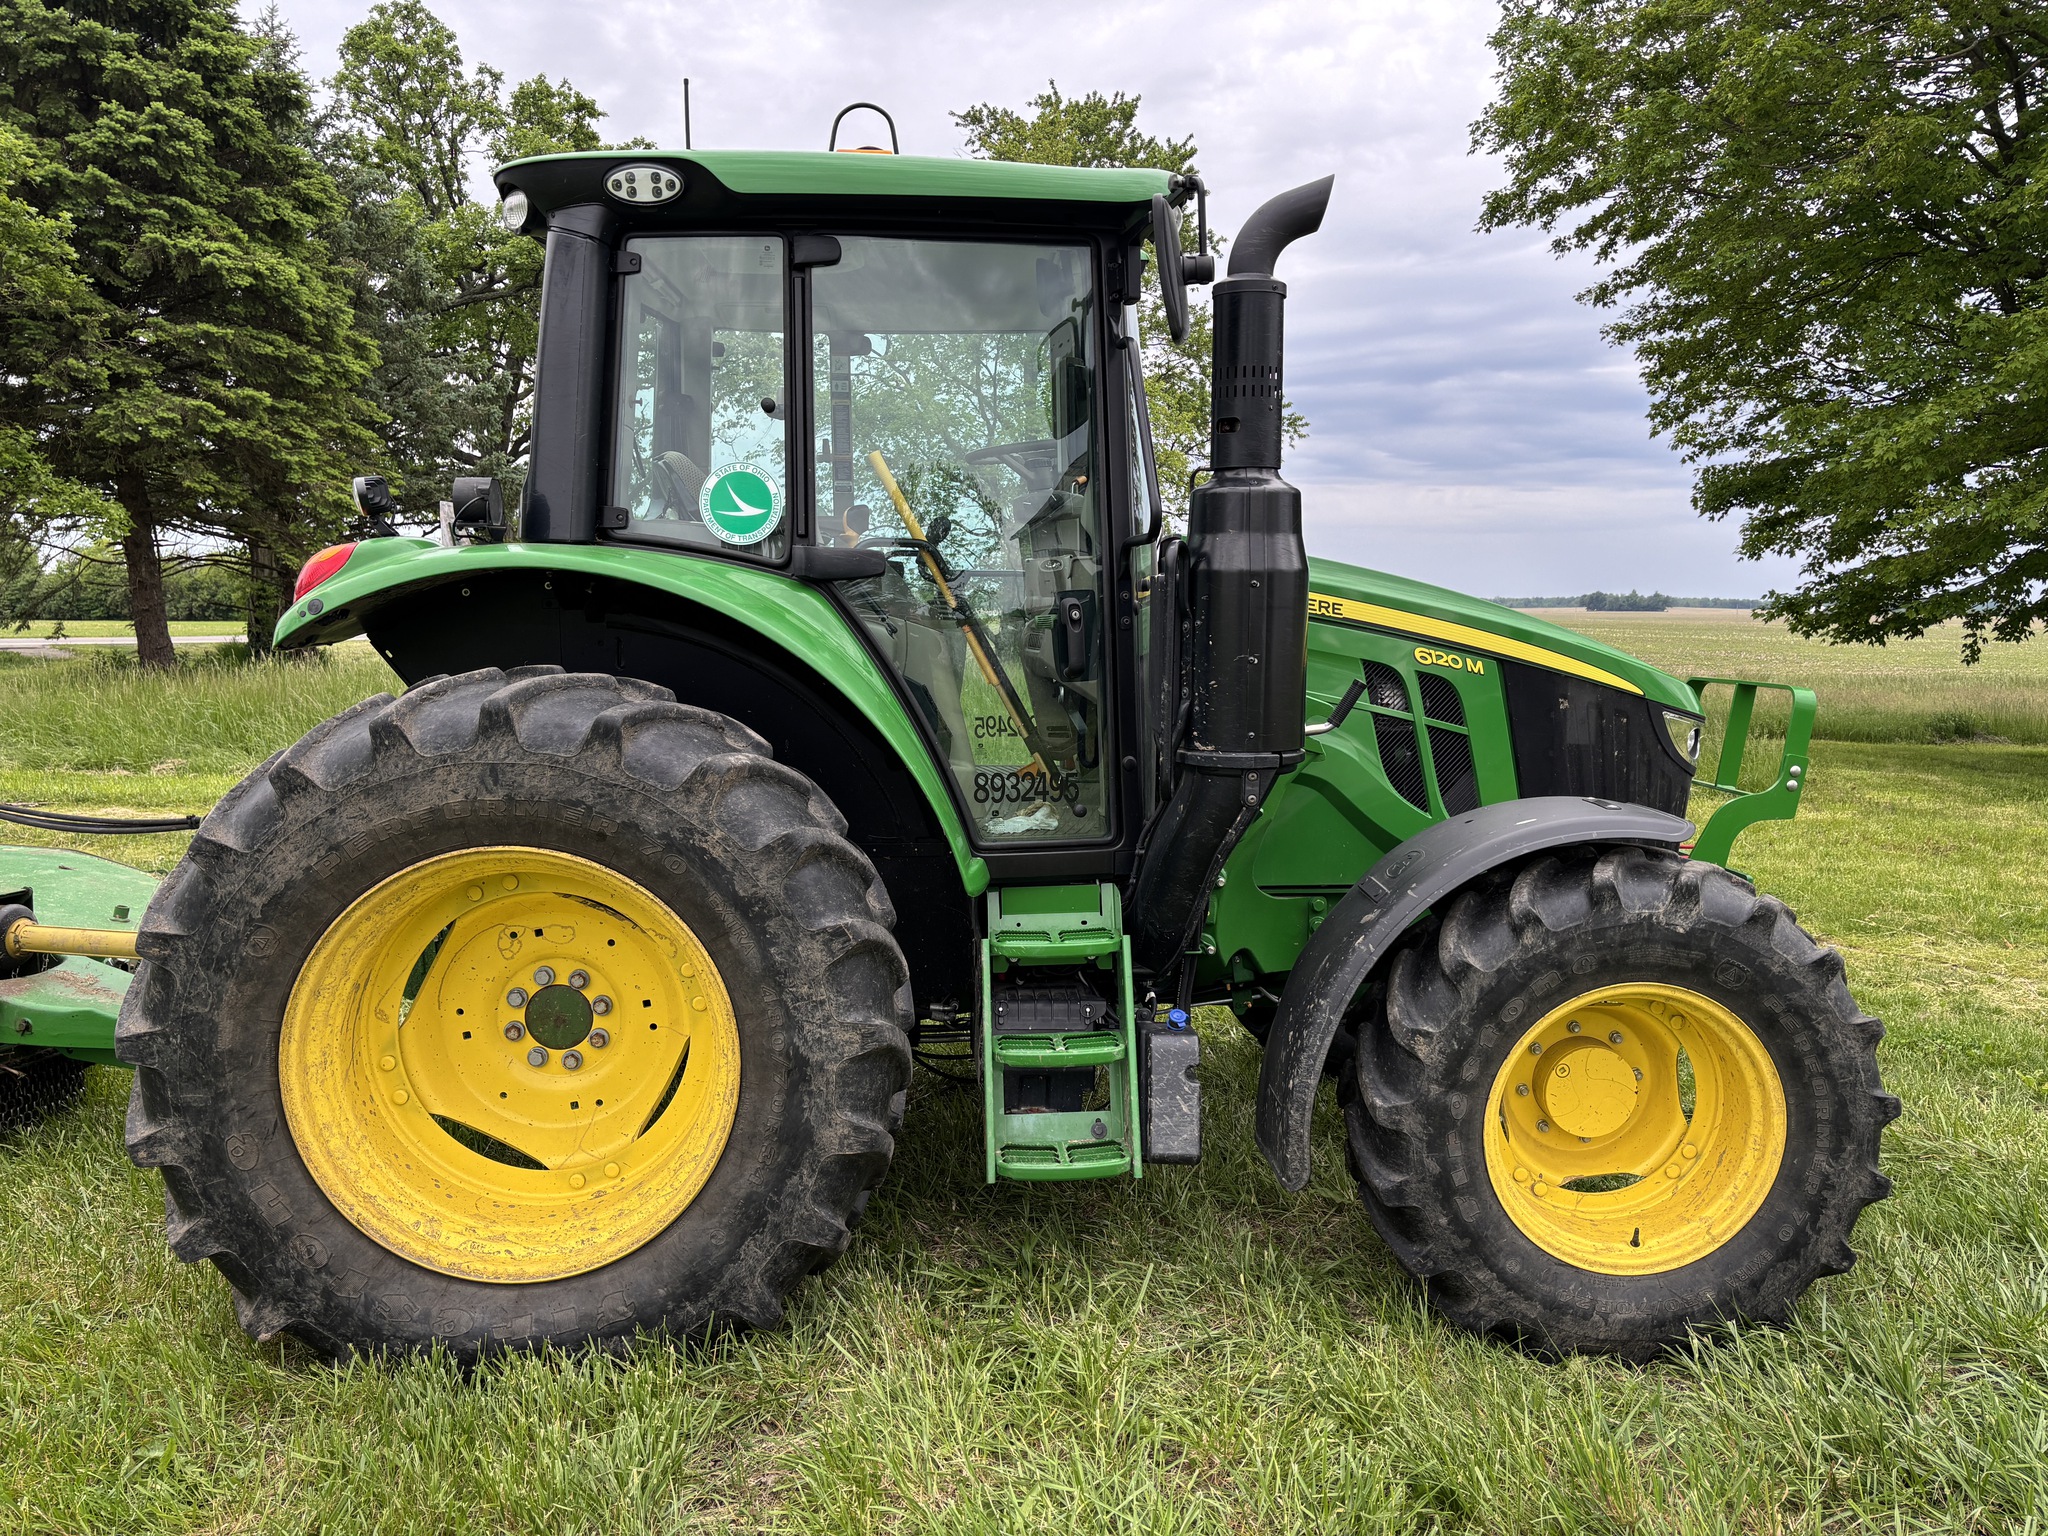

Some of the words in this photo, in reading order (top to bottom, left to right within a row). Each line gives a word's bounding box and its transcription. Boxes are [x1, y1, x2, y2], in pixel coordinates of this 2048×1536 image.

[715, 464, 738, 479] STATE
[752, 467, 770, 483] OHIO
[702, 487, 725, 537] DEPARTMENT
[725, 533, 736, 541] OF
[738, 492, 780, 542] TRANSPORTATION
[1308, 598, 1343, 616] ERE
[1414, 647, 1464, 671] 6120
[1465, 657, 1485, 675] M
[974, 771, 1080, 804] 8932495
[311, 798, 619, 879] PERFORMER
[639, 836, 688, 875] 70
[707, 891, 756, 954] EXTRA
[748, 985, 792, 1187] 480/70R34
[1446, 953, 1599, 1223] Firestone
[1762, 994, 1831, 1195] PERFORMER
[224, 1132, 636, 1338] Firestone
[1778, 1209, 1810, 1242] 70
[1725, 1249, 1773, 1290] EXTRA
